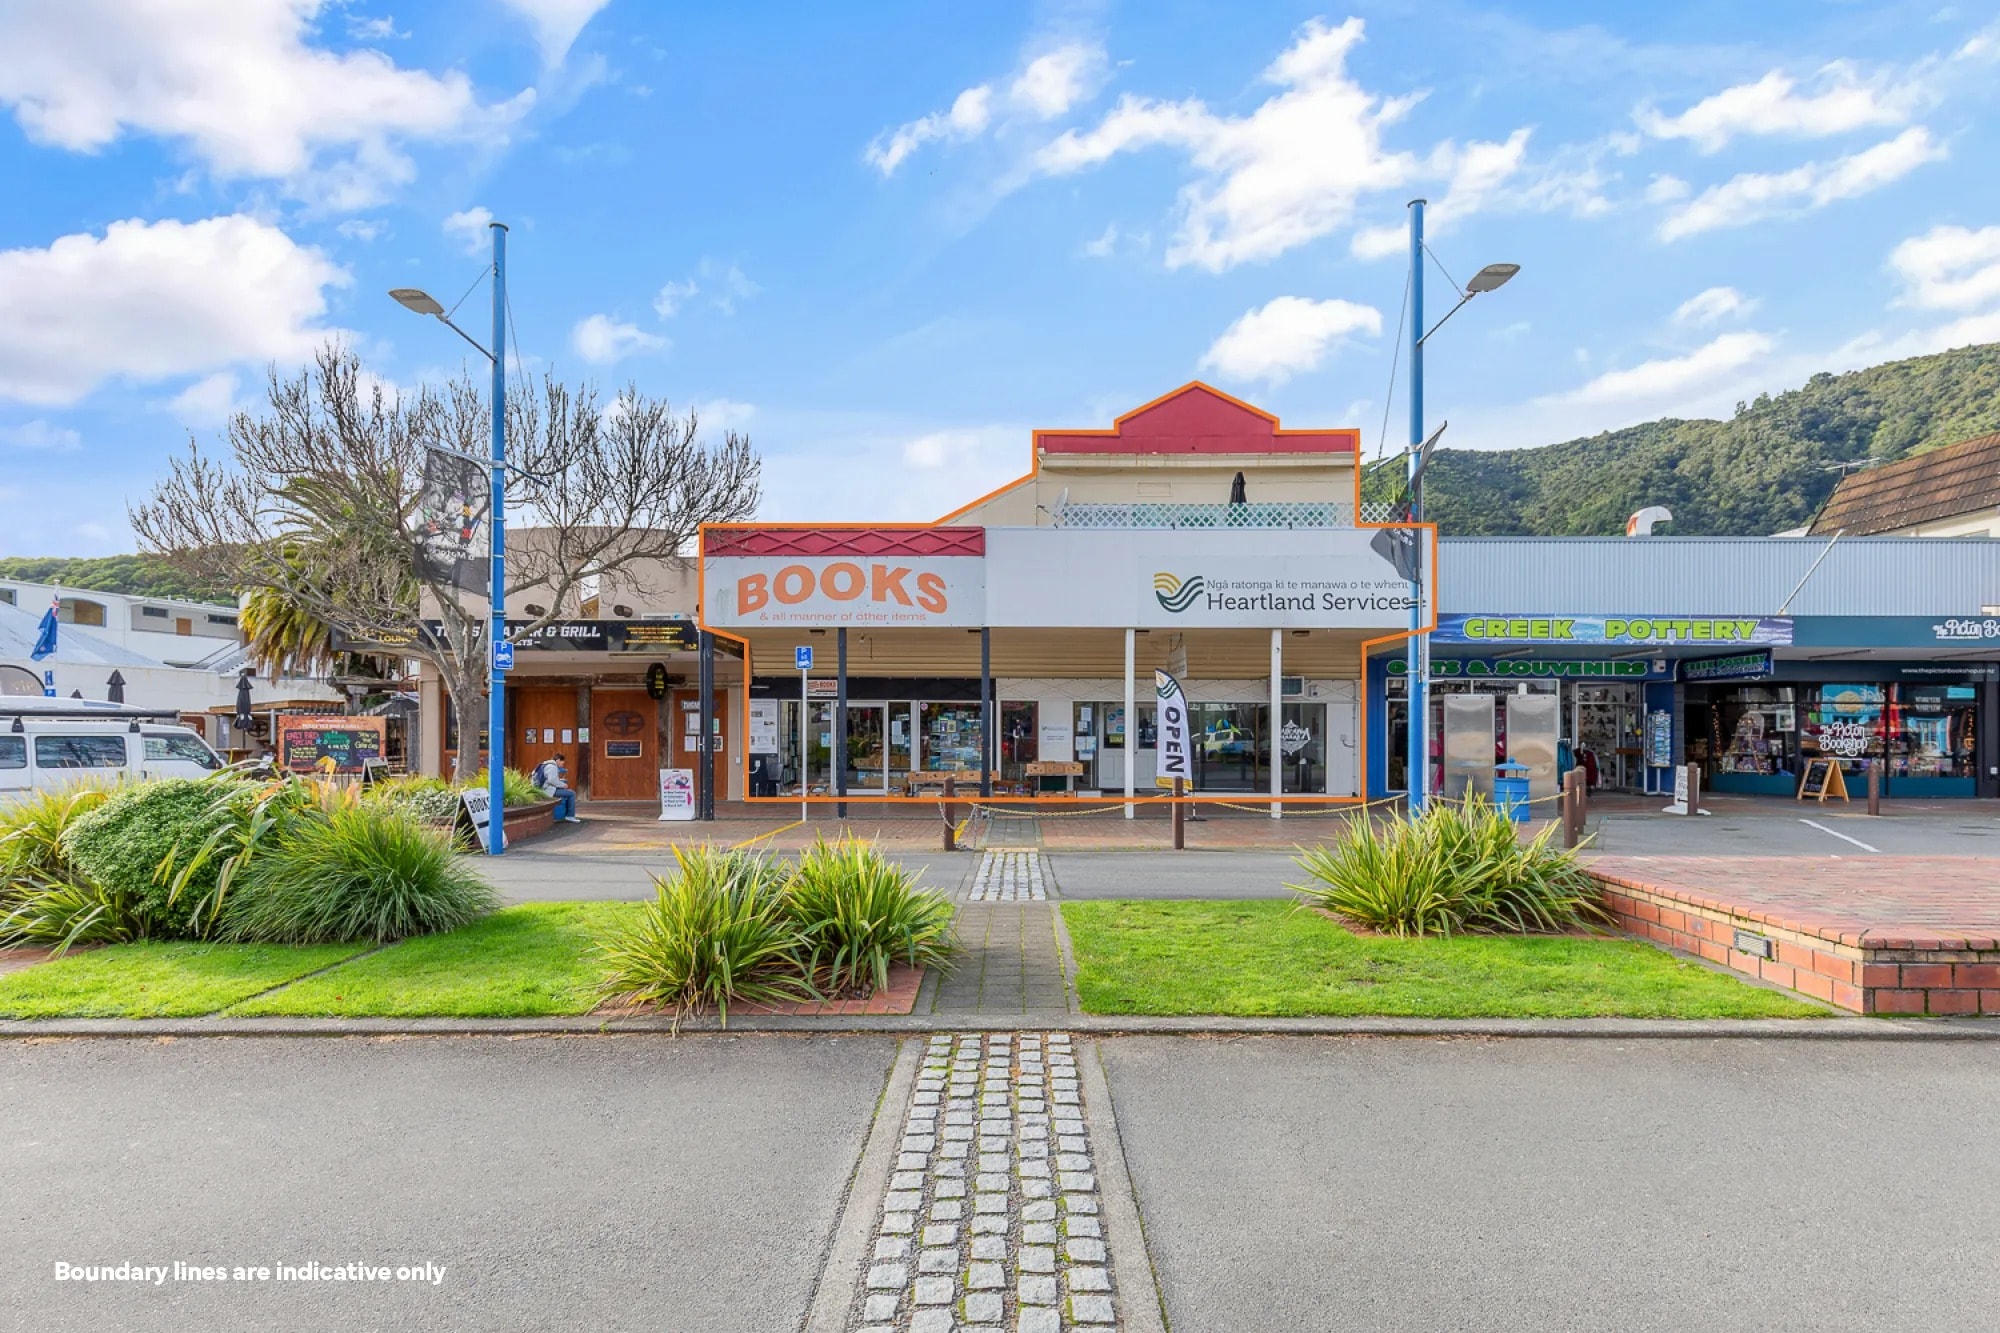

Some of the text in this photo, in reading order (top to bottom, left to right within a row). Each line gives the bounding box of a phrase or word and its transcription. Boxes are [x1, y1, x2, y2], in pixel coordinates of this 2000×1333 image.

[738, 562, 947, 616] BOOKS
[1231, 580, 1272, 592] ratonga
[1276, 579, 1284, 590] ki
[1287, 580, 1298, 590] te
[1301, 581, 1347, 590] manawa
[1350, 581, 1357, 590] o
[1360, 580, 1371, 590] te
[1206, 592, 1409, 610] Heartland Services
[759, 612, 769, 621] &
[773, 612, 786, 621] all
[841, 612, 853, 621] of
[856, 612, 889, 621] other
[892, 612, 926, 621] items
[546, 626, 557, 637] &
[560, 626, 601, 637] GRILL
[1463, 618, 1759, 640] CREEK POTTERY
[1945, 619, 1983, 638] Picton
[1466, 661, 1493, 676] &
[1494, 660, 1648, 676] SOUVENIRS
[1832, 721, 1865, 737] Picton
[1165, 706, 1185, 773] OPEN
[1819, 734, 1868, 757] Bookshop
